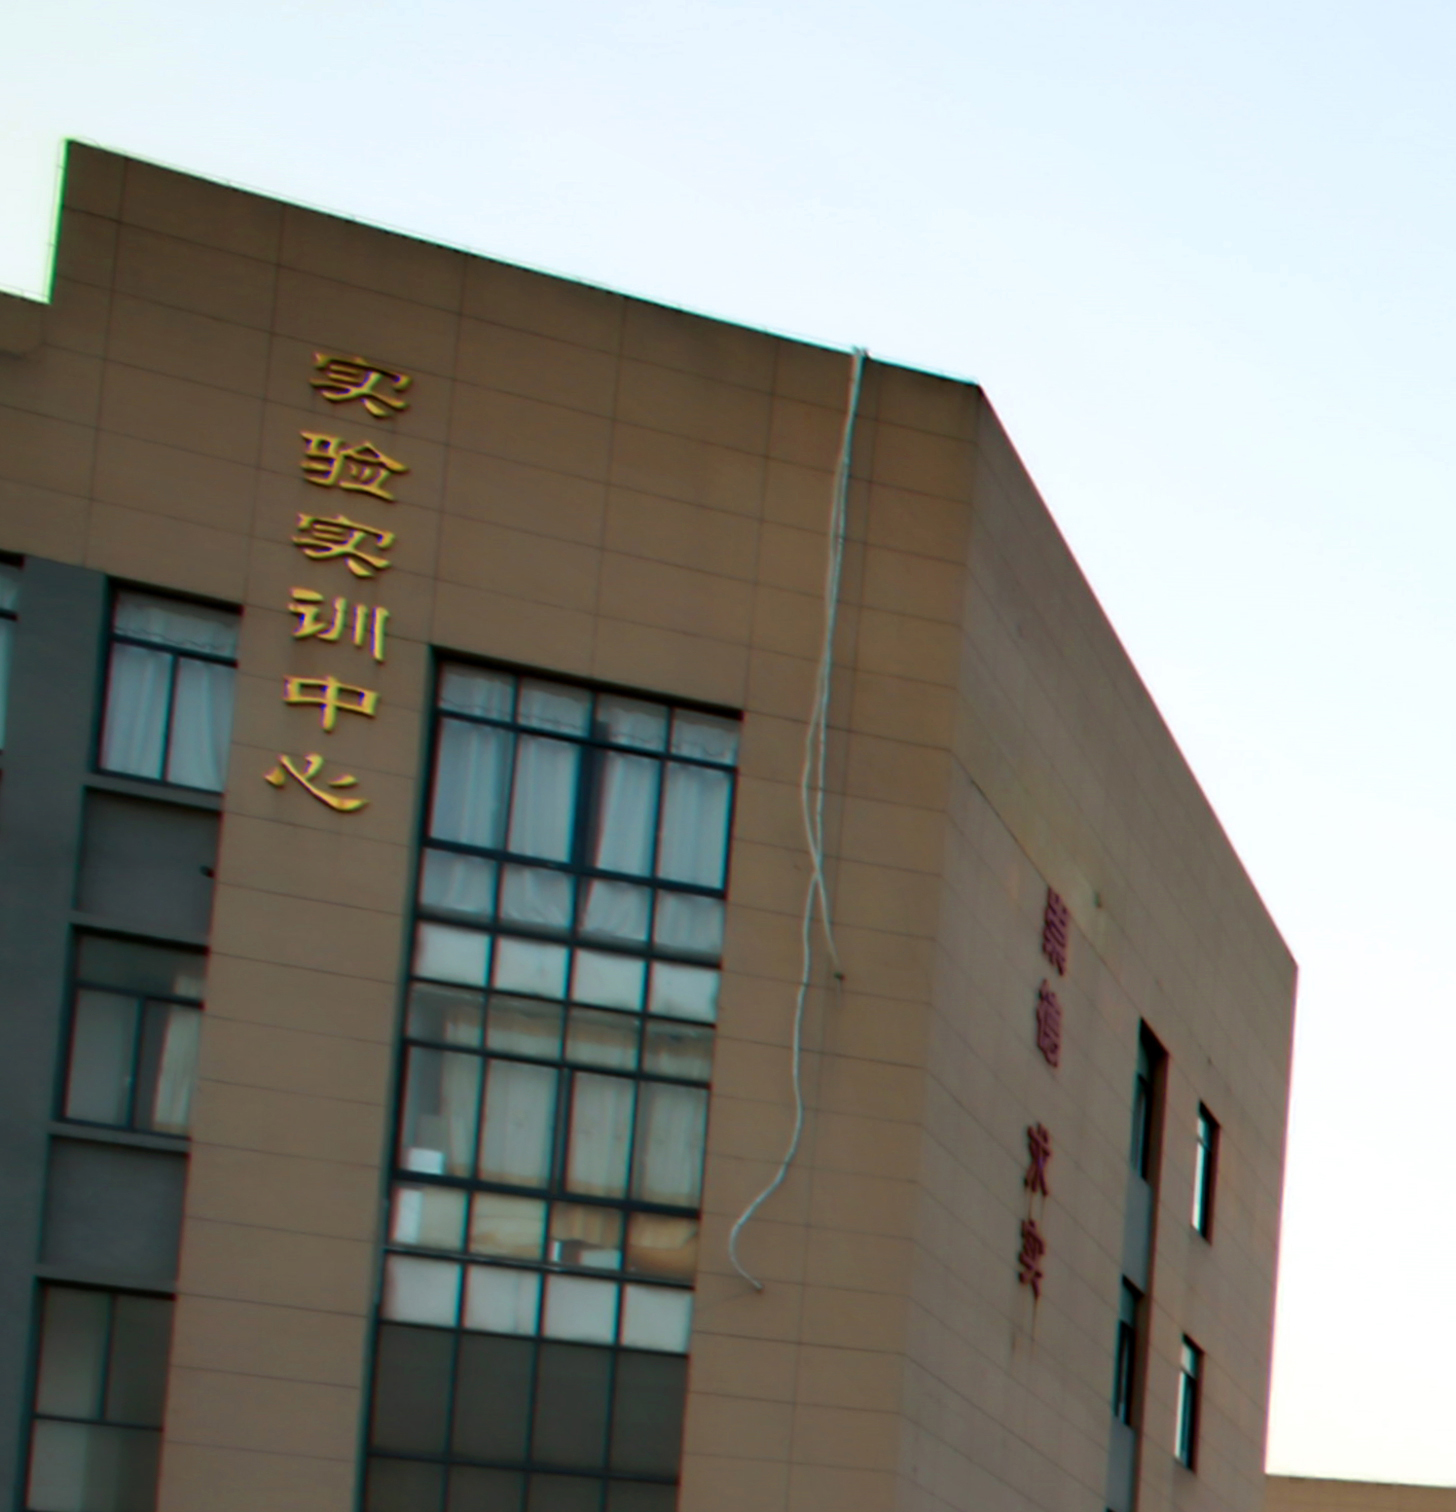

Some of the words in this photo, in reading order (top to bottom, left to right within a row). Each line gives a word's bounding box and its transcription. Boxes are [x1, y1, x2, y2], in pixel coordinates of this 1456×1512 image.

[264, 352, 412, 812] 实验实训中心
